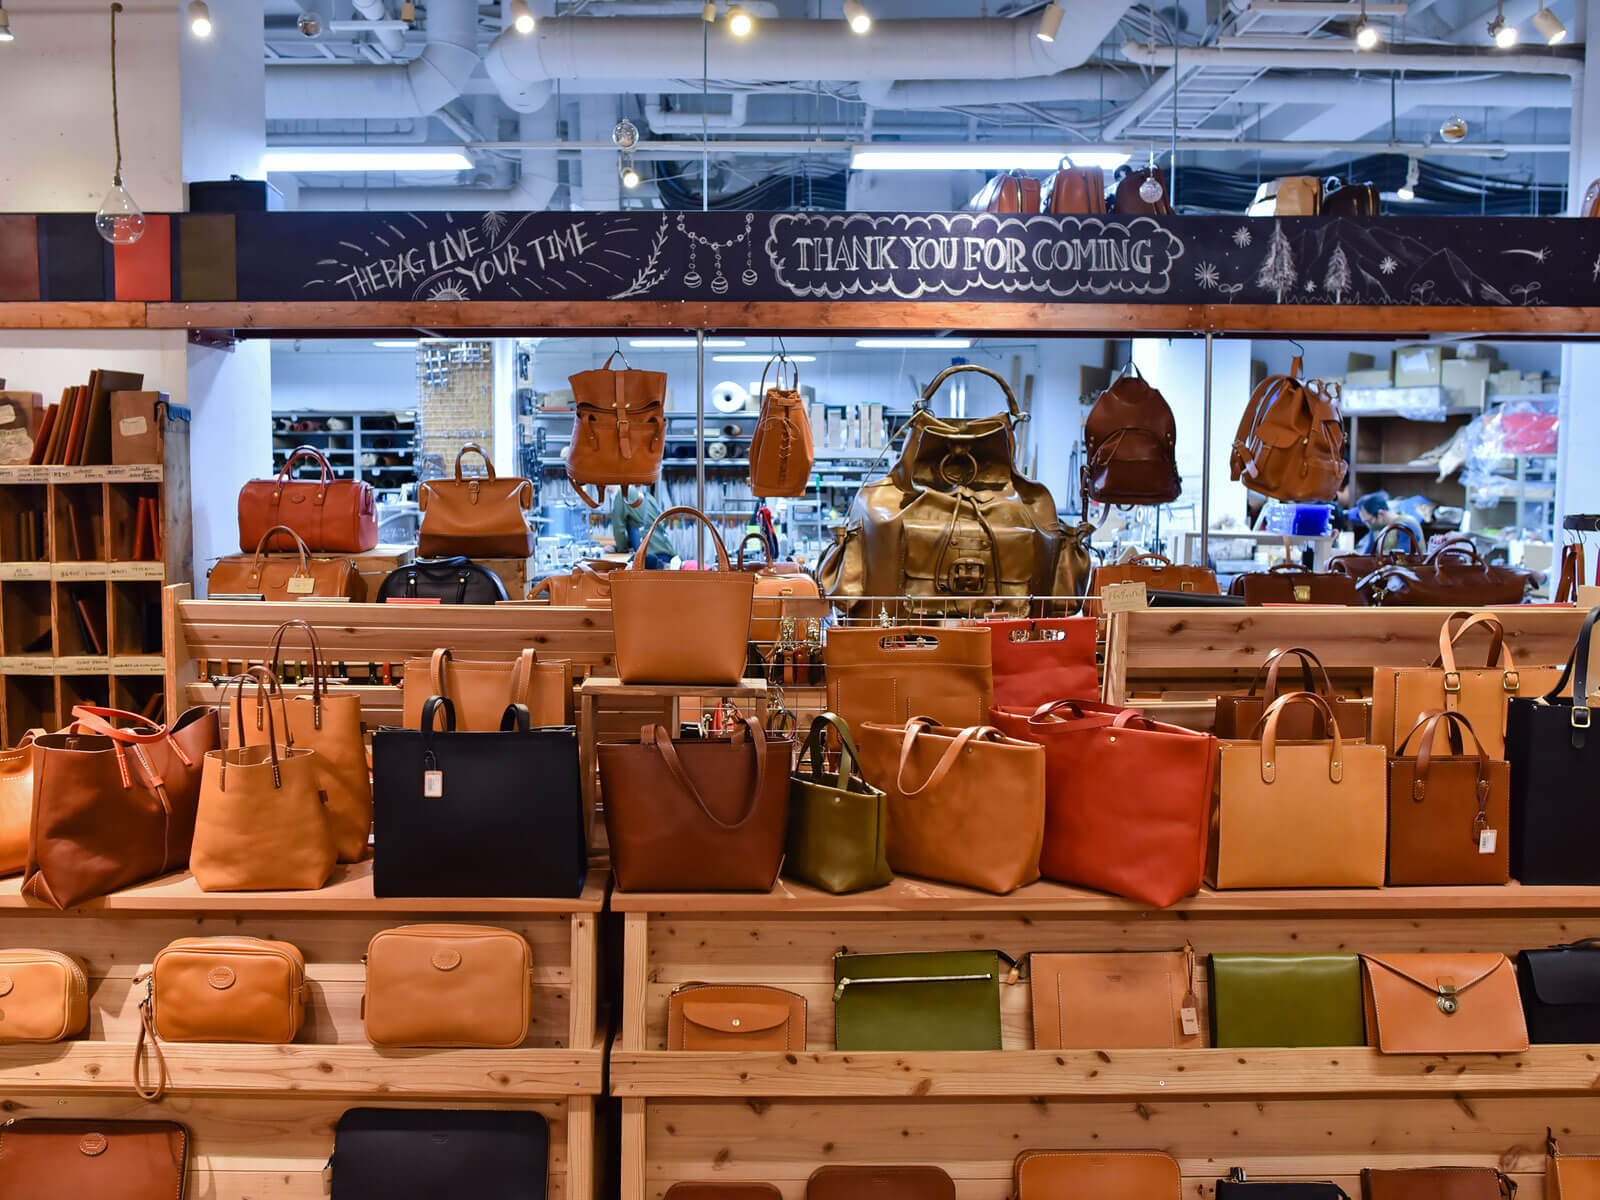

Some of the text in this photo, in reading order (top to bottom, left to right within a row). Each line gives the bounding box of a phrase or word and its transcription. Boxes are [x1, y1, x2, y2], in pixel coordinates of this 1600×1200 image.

[428, 227, 486, 270] LIVE
[454, 221, 598, 293] YOUR TIME
[792, 235, 1154, 274] THANK YOU FOR COMING
